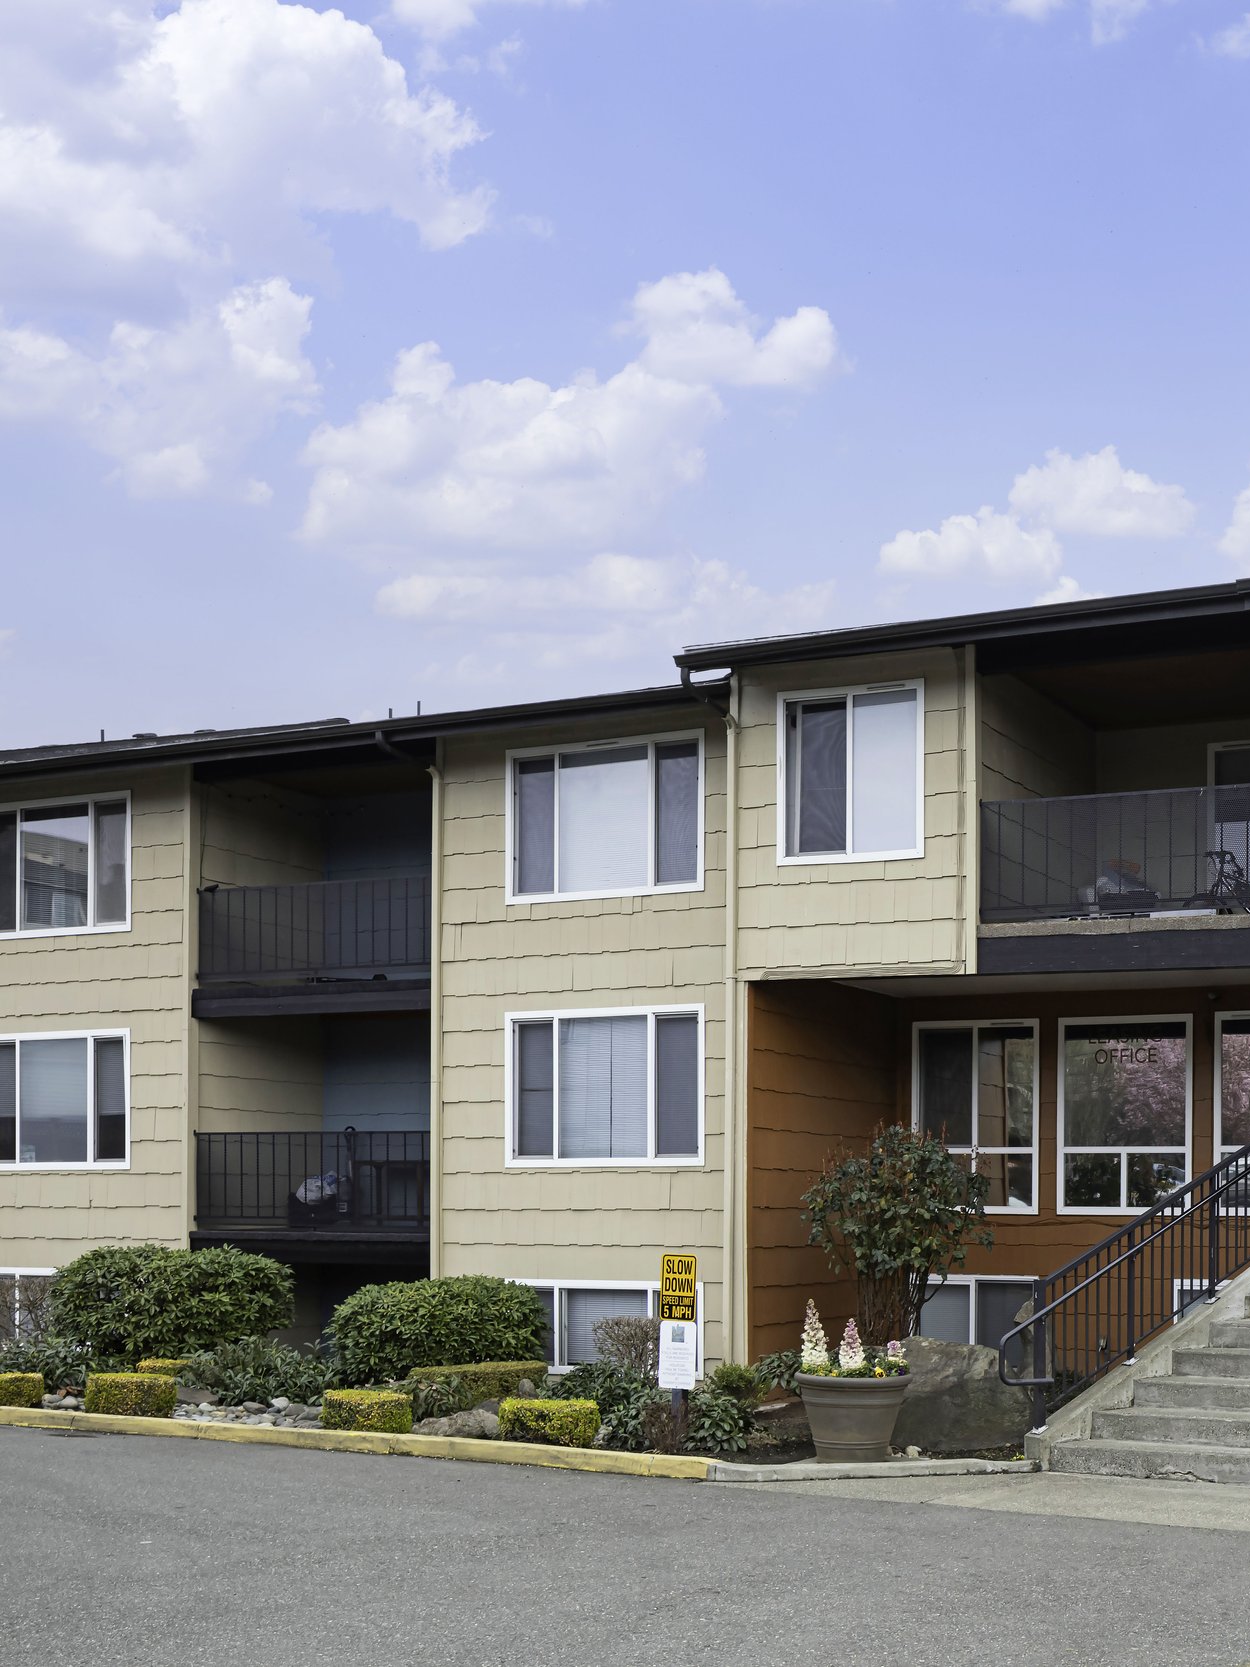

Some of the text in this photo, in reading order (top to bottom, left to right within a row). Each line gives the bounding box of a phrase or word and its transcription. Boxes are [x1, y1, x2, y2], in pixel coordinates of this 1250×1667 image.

[1094, 1047, 1158, 1065] OFFICE
[666, 1259, 693, 1275] SLOW
[664, 1277, 693, 1293] DOWN
[662, 1296, 694, 1306] SPEED LIMIT
[663, 1305, 692, 1319] 5 MPH
